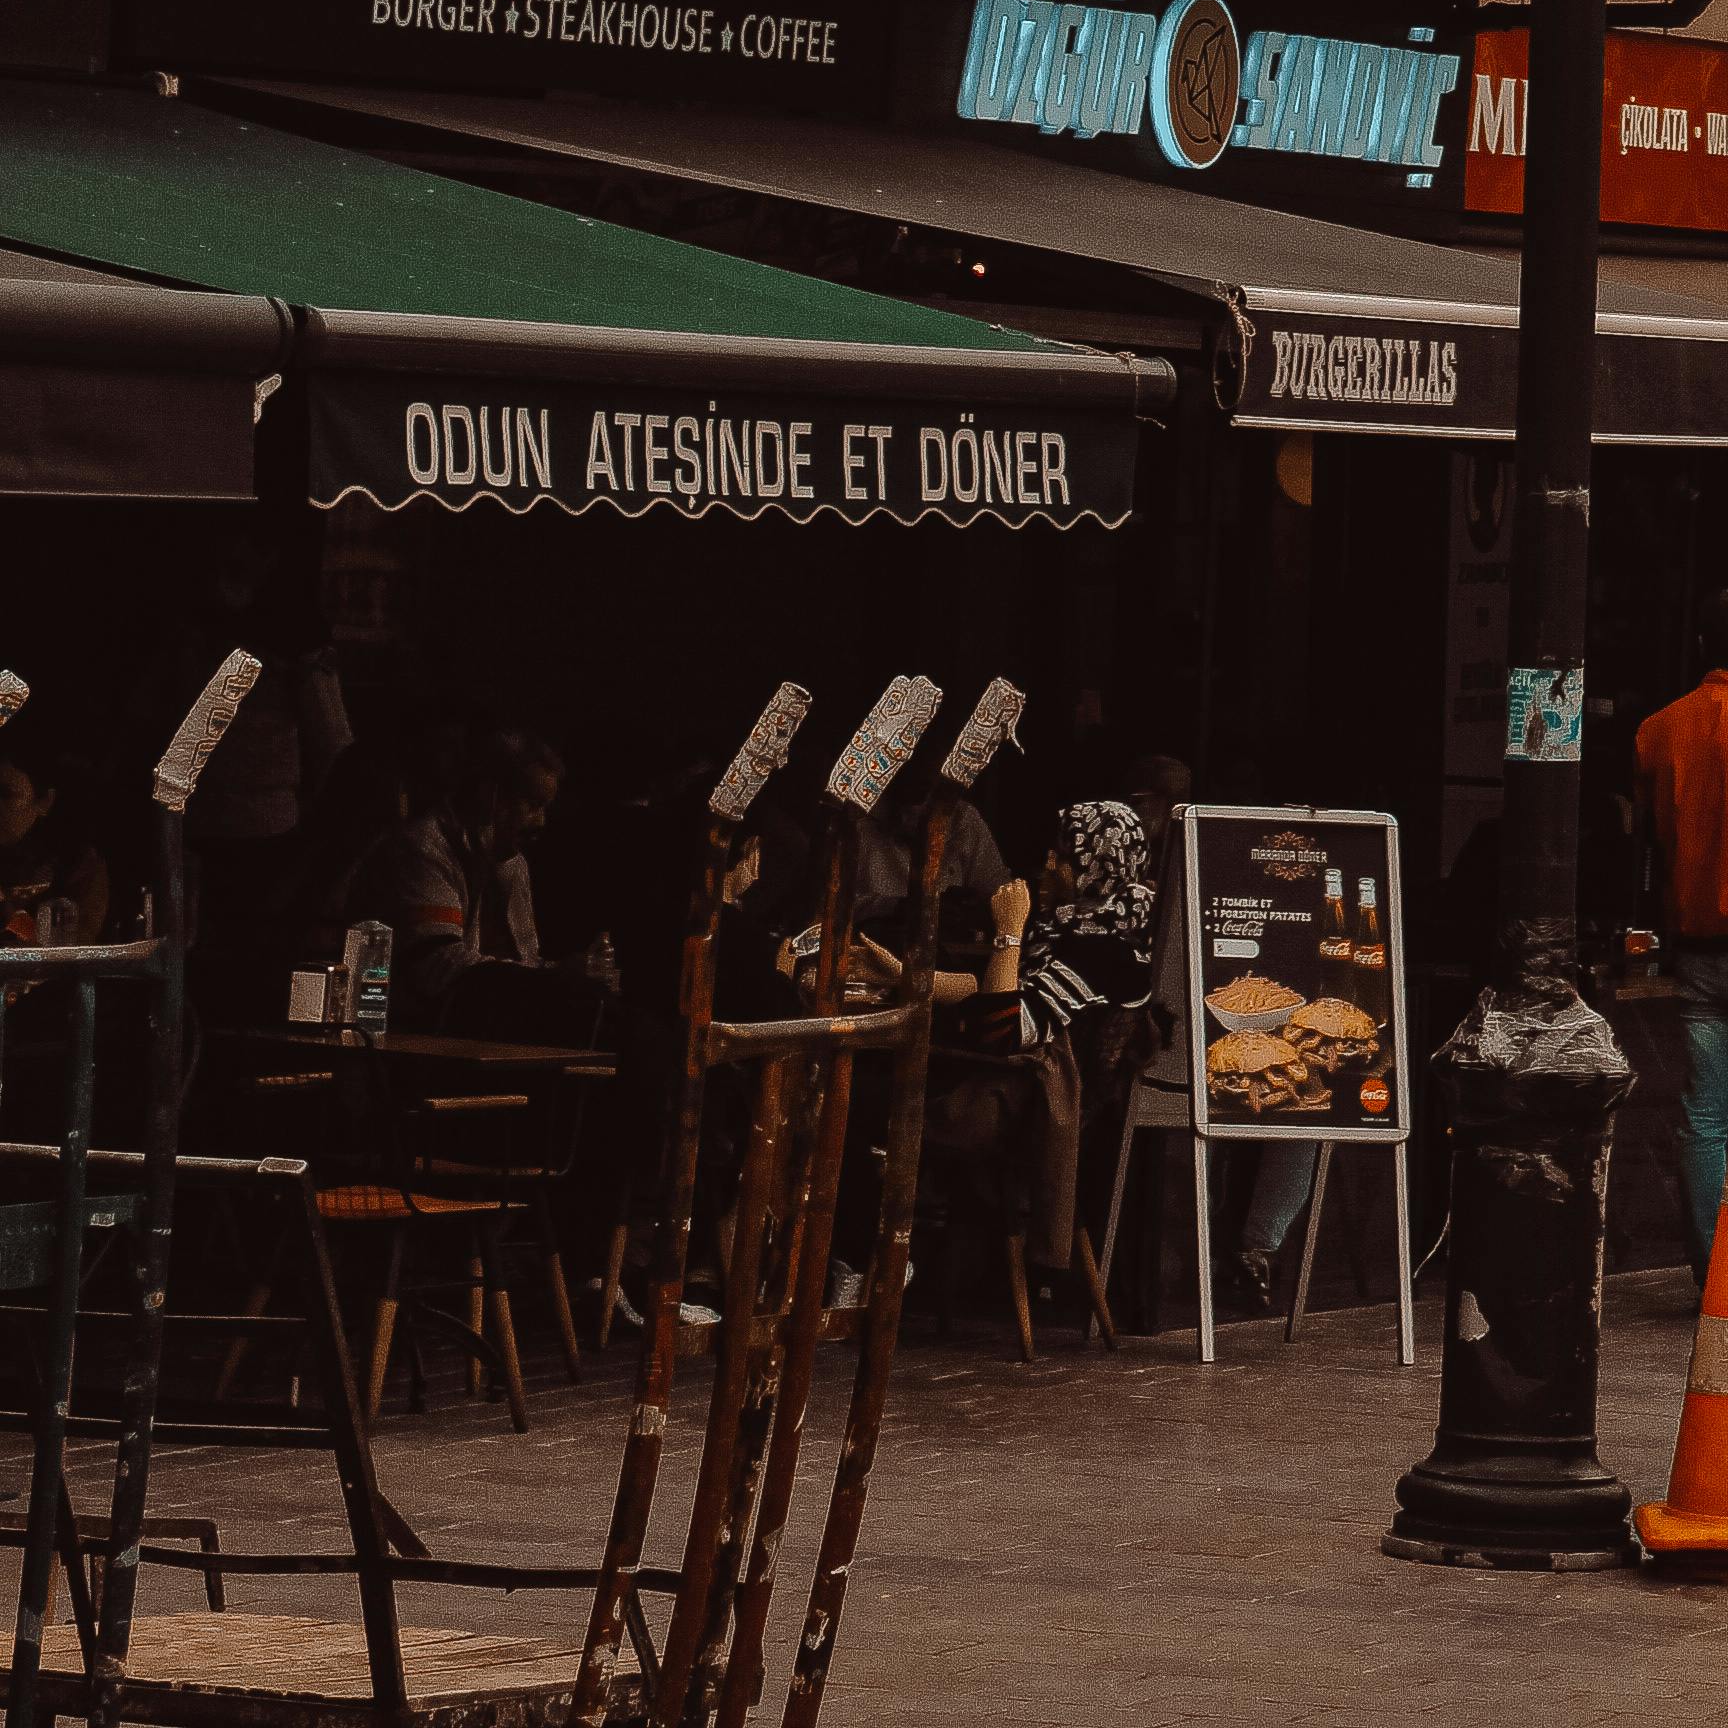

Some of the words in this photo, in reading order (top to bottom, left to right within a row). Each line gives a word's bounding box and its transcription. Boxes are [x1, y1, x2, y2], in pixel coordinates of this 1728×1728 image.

[740, 14, 839, 66] COFFEE
[1620, 95, 1689, 156] ÇİKOLATA
[1270, 330, 1458, 405] BURGERILLAS
[405, 401, 551, 489] ODUN
[585, 400, 814, 510] ATEŞİNDE
[843, 423, 894, 501] ET
[919, 412, 1071, 506] DÖNER
[1212, 897, 1219, 907] 2
[1260, 899, 1273, 909] ET
[1213, 924, 1220, 933] 2
[1269, 911, 1312, 922] PATATES
